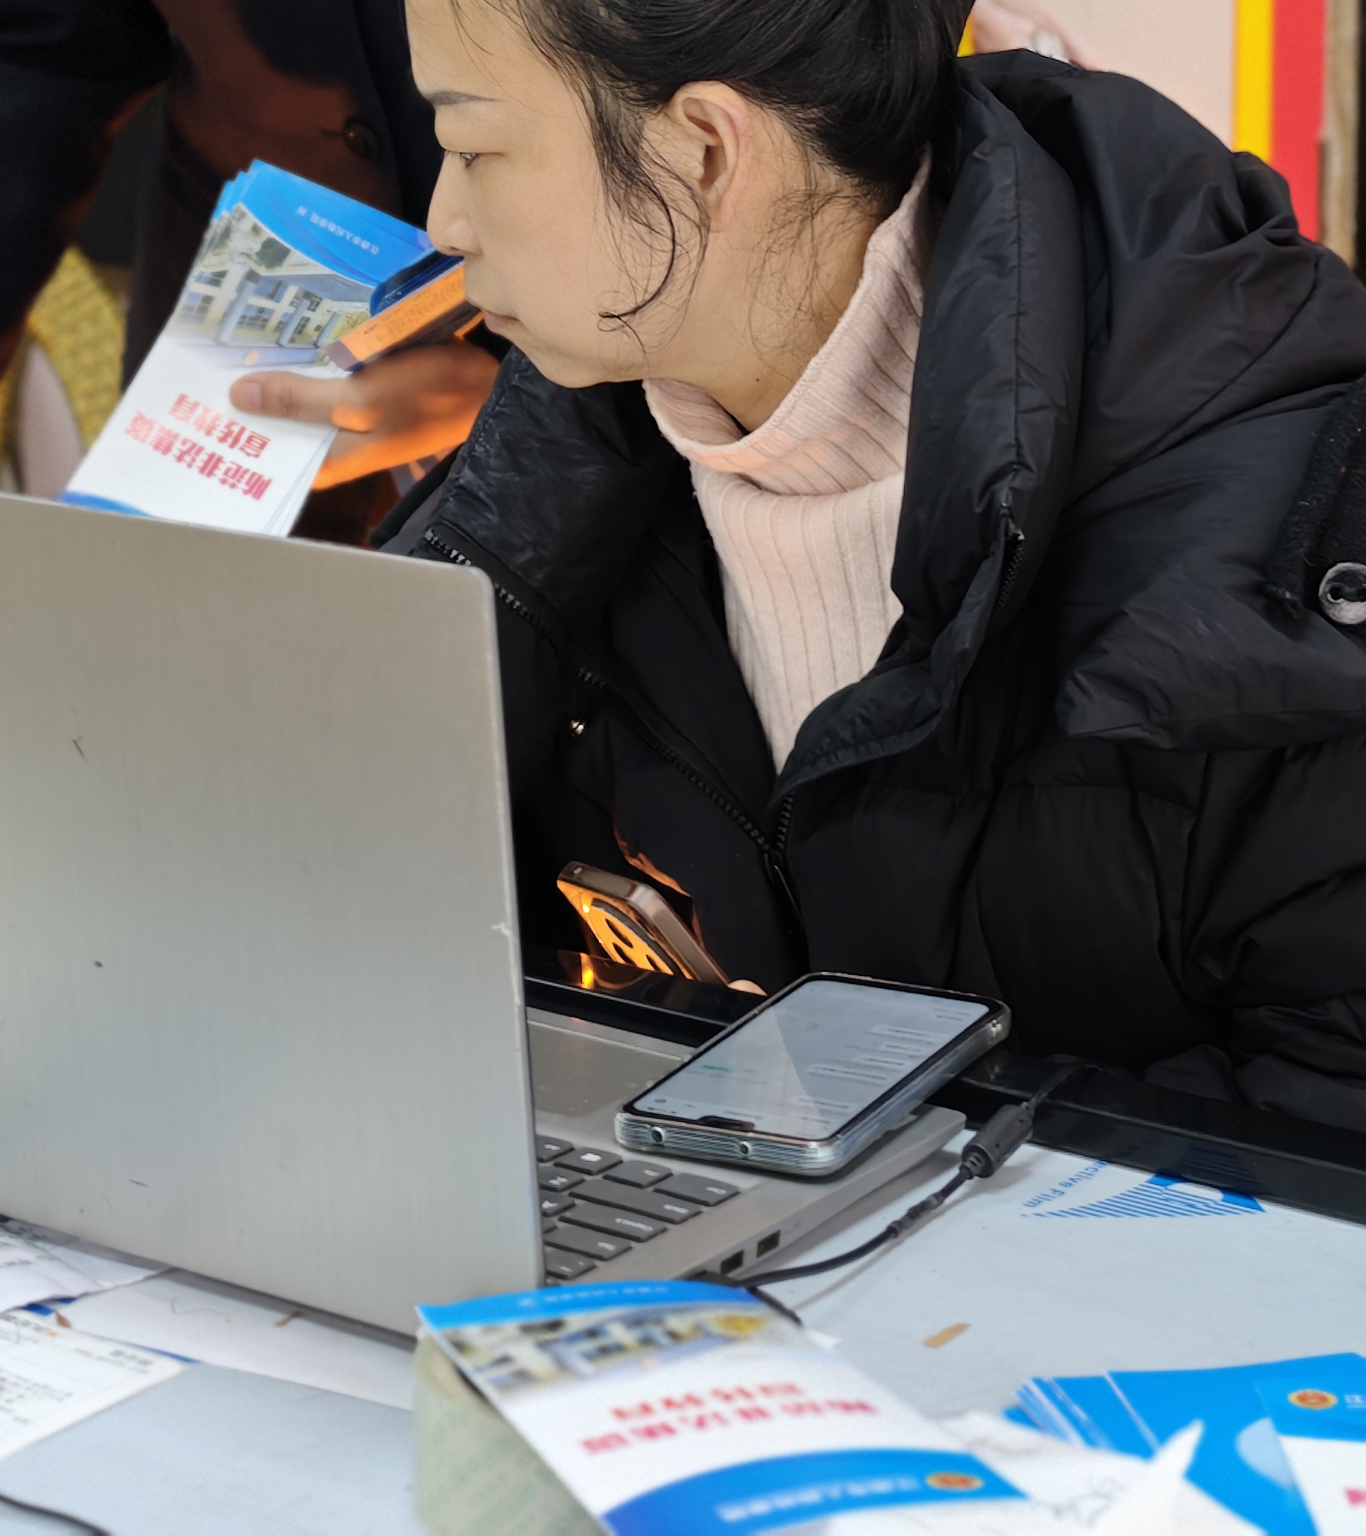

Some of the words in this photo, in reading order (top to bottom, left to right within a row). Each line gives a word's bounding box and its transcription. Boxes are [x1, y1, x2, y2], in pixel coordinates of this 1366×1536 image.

[123, 410, 273, 500] 防范非法集资
[168, 392, 272, 460] 宣传教育
